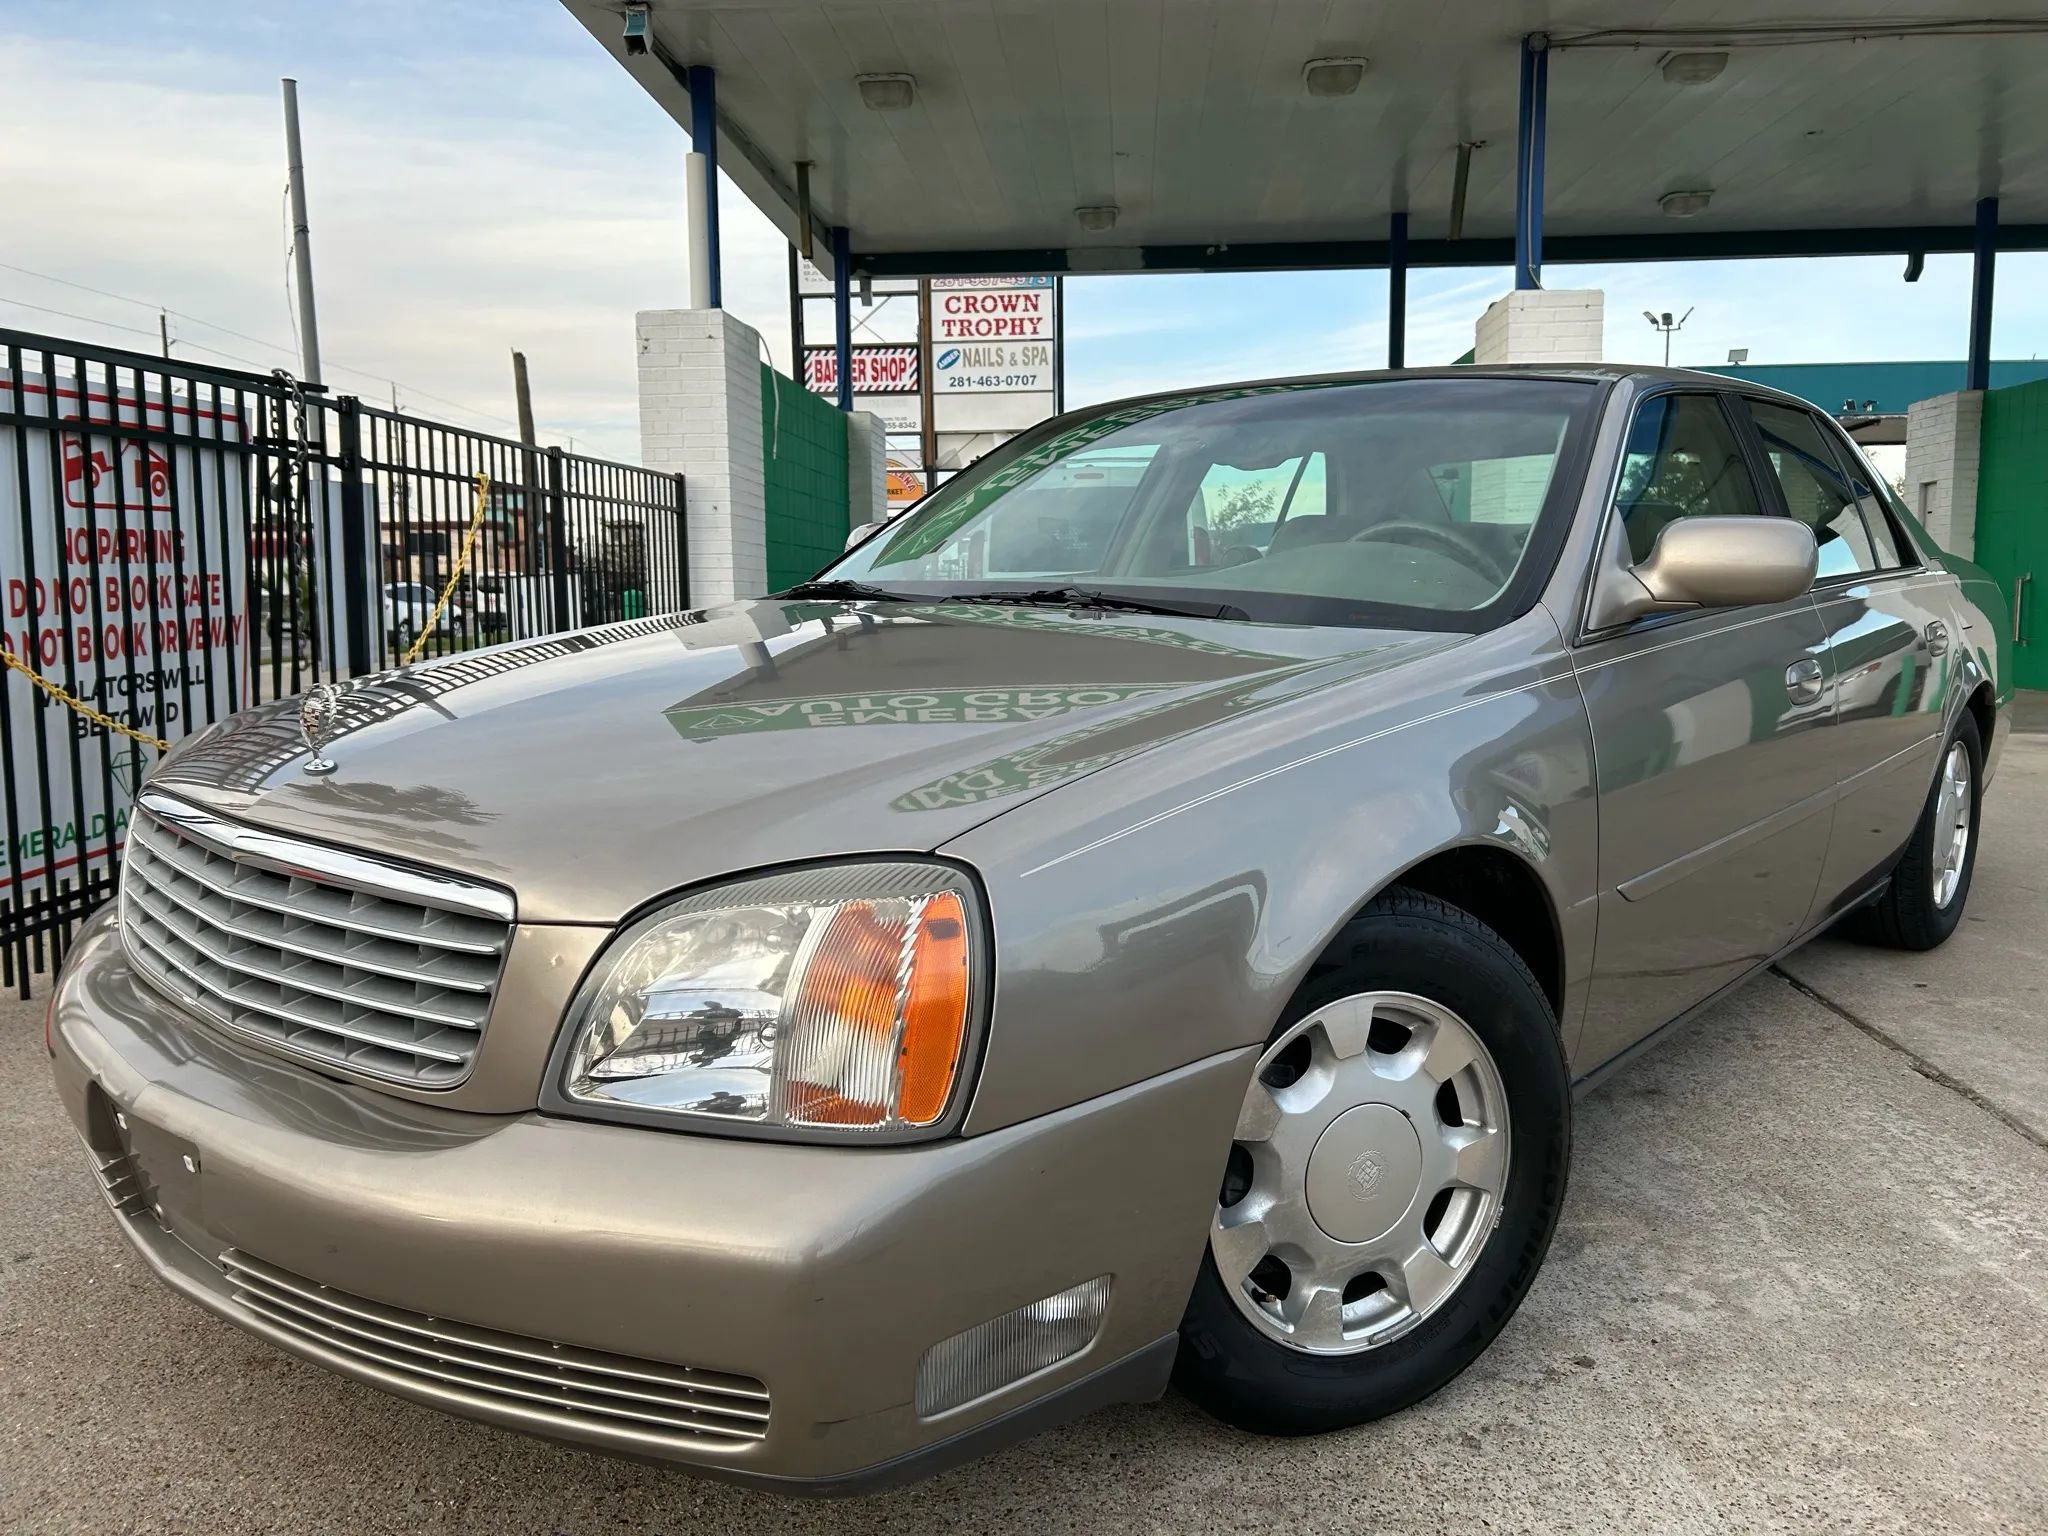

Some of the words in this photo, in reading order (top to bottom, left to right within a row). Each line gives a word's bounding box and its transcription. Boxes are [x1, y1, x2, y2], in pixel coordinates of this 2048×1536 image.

[944, 294, 1040, 314] CROWN
[942, 317, 1043, 337] TROPHY
[815, 357, 866, 383] BAER
[871, 357, 907, 382] SHOP
[962, 347, 1004, 368] NAILS
[1009, 352, 1018, 367] &
[1022, 346, 1049, 366] SPA
[949, 375, 1037, 387] 281-463-0707
[8, 577, 46, 618] DO
[105, 575, 173, 612] BOK
[77, 621, 148, 663] BOK
[155, 615, 242, 654] DRVEWY
[40, 671, 159, 708] VILATORS
[161, 665, 205, 691] WLL
[107, 702, 179, 732] TOWD
[0, 812, 109, 867] MERAD
